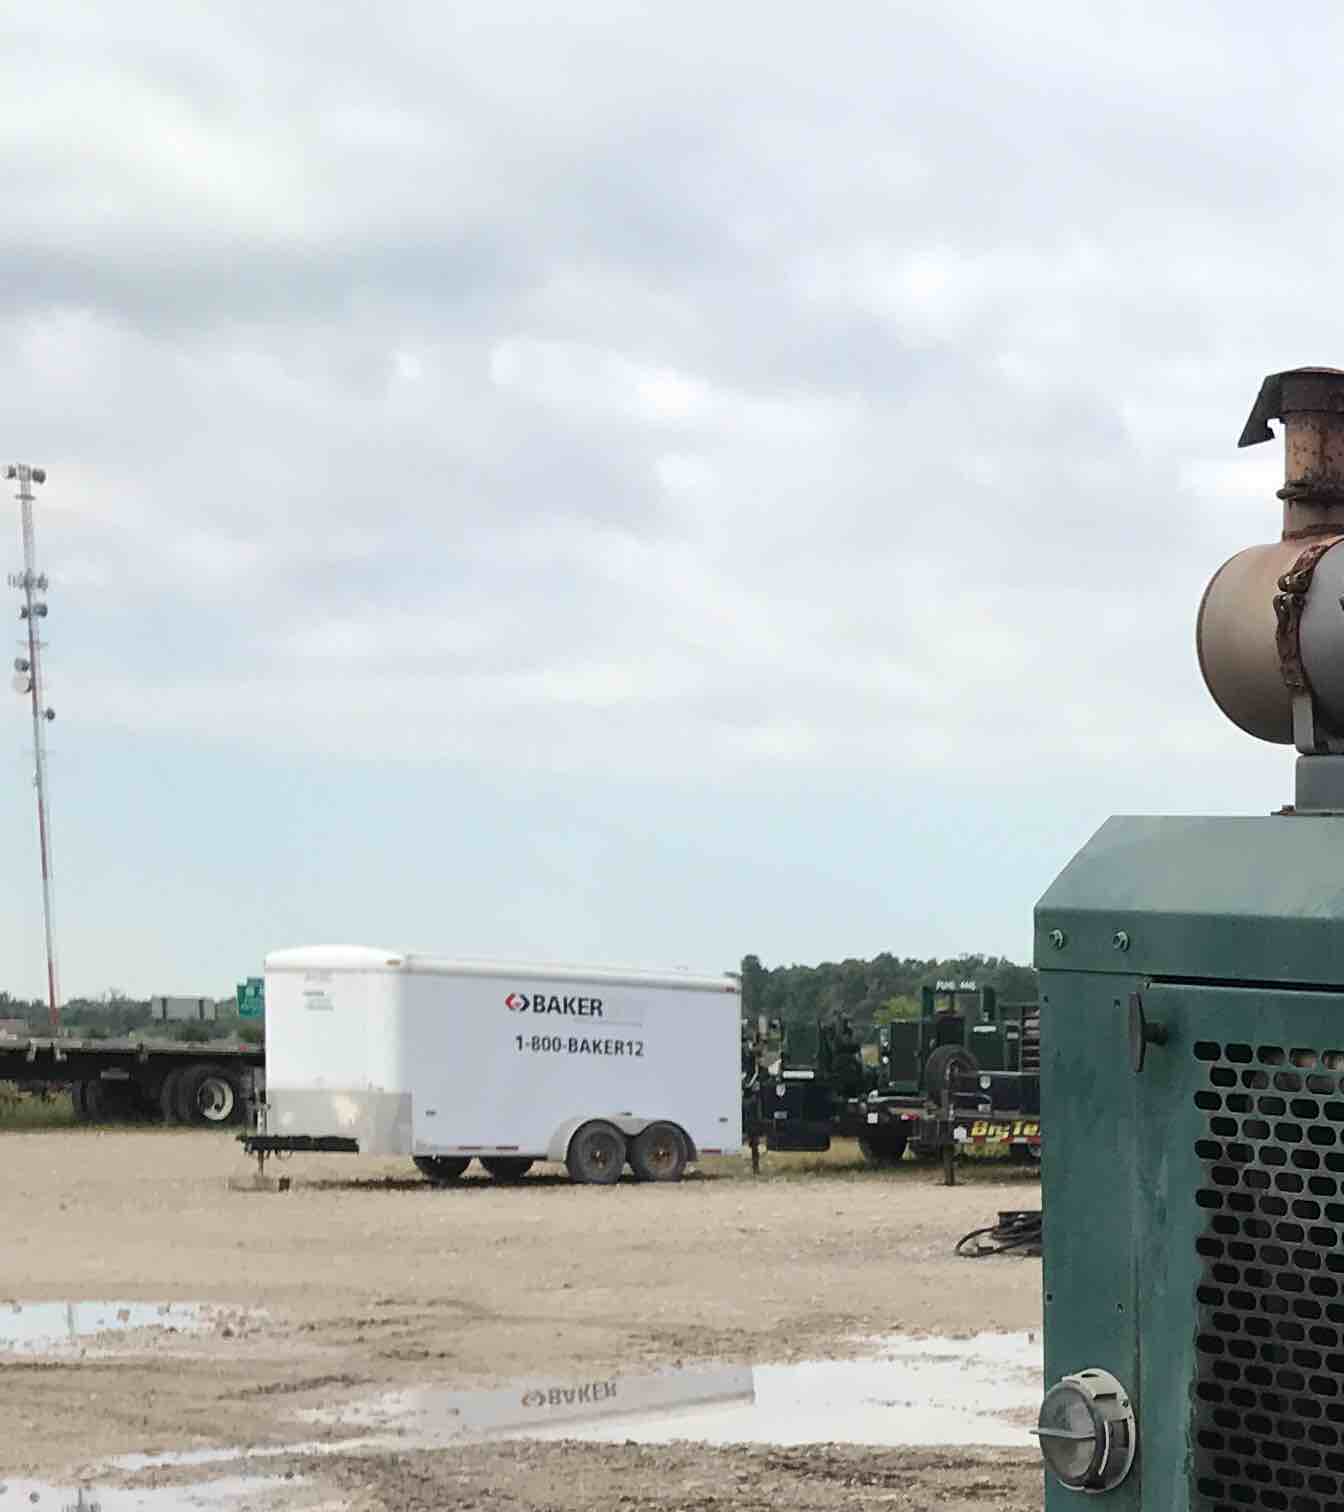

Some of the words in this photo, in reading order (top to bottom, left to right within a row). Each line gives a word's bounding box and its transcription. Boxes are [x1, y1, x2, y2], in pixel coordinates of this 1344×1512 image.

[533, 994, 603, 1017] BAKER
[515, 1035, 644, 1056] 1-800-BAKER12
[1012, 1120, 1039, 1136] Te
